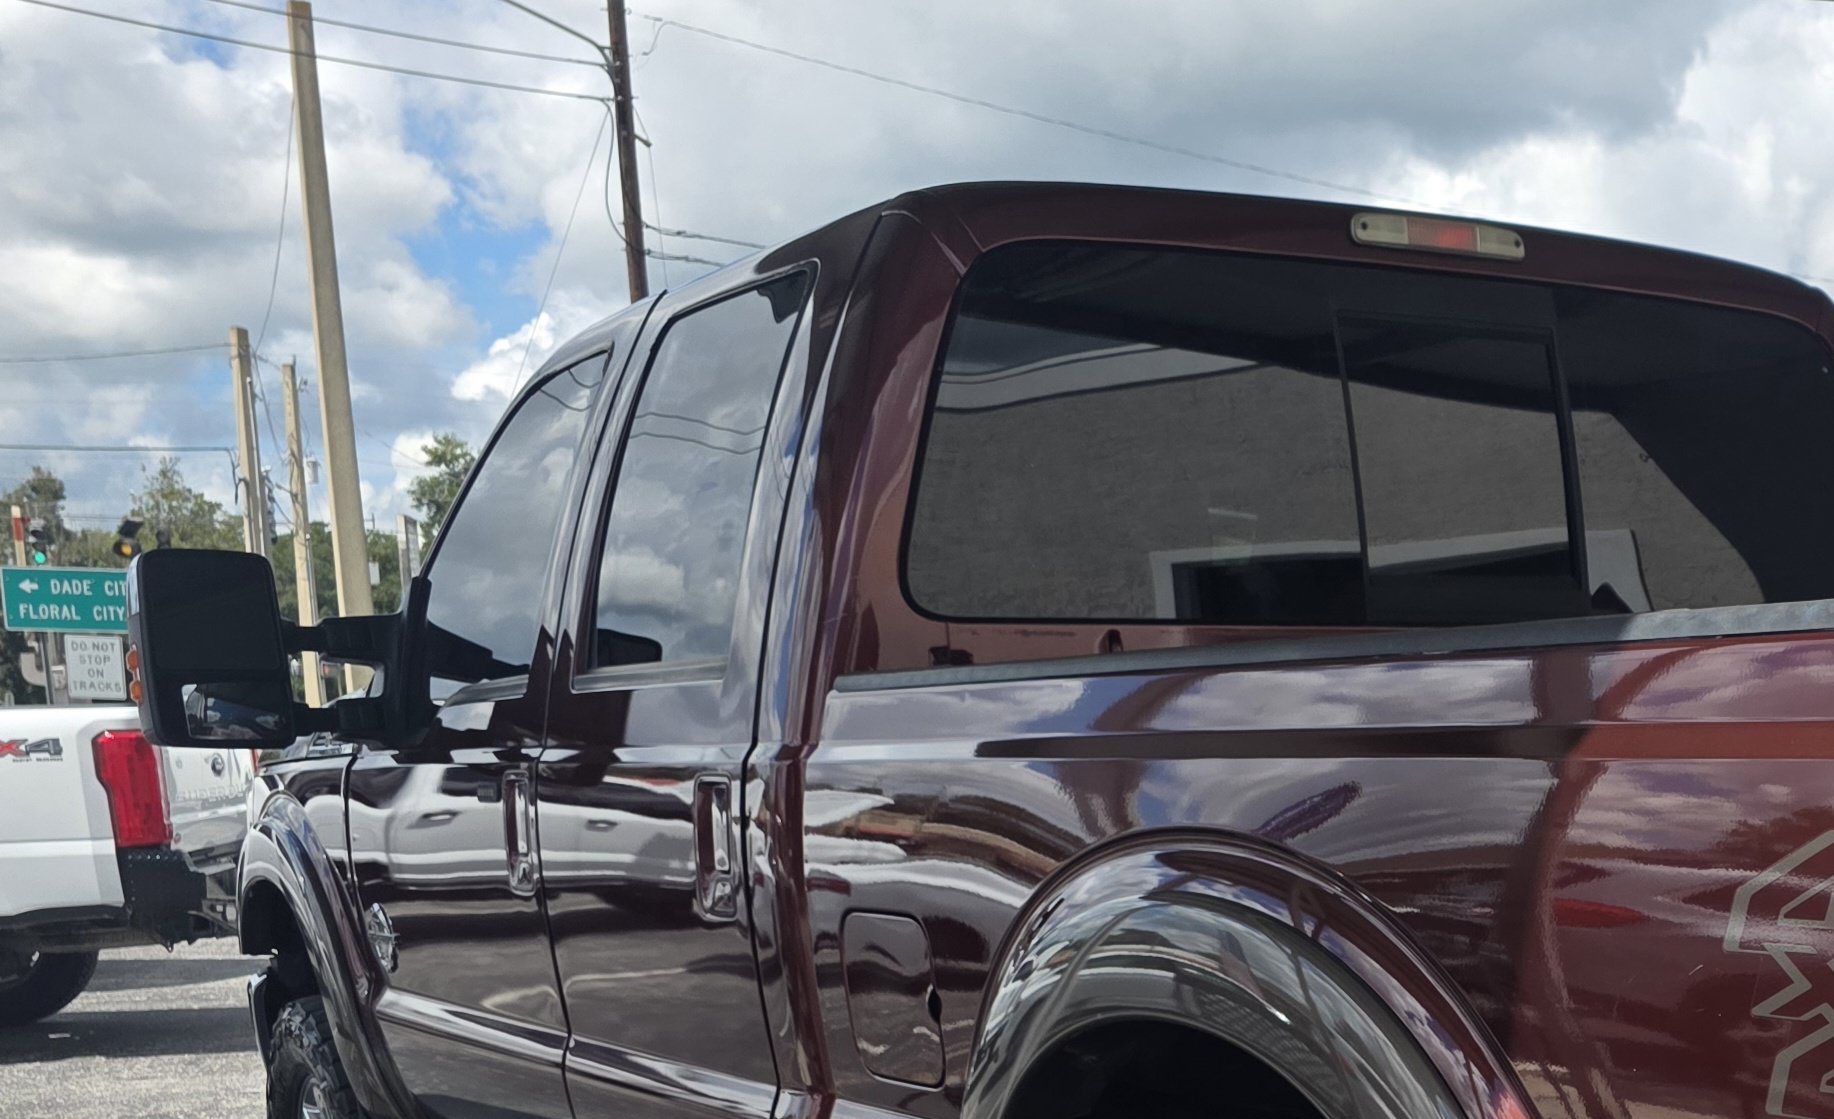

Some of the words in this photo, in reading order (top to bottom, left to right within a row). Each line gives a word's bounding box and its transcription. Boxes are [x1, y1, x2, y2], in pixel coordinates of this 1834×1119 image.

[50, 578, 93, 596] DADE
[104, 580, 126, 597] CIT
[19, 603, 82, 621] FLORAL
[93, 605, 125, 622] CITY
[71, 641, 88, 652] DO
[92, 642, 116, 653] NOT
[79, 655, 111, 666] STOP
[87, 668, 105, 679] ON
[72, 681, 122, 692] TRACKS
